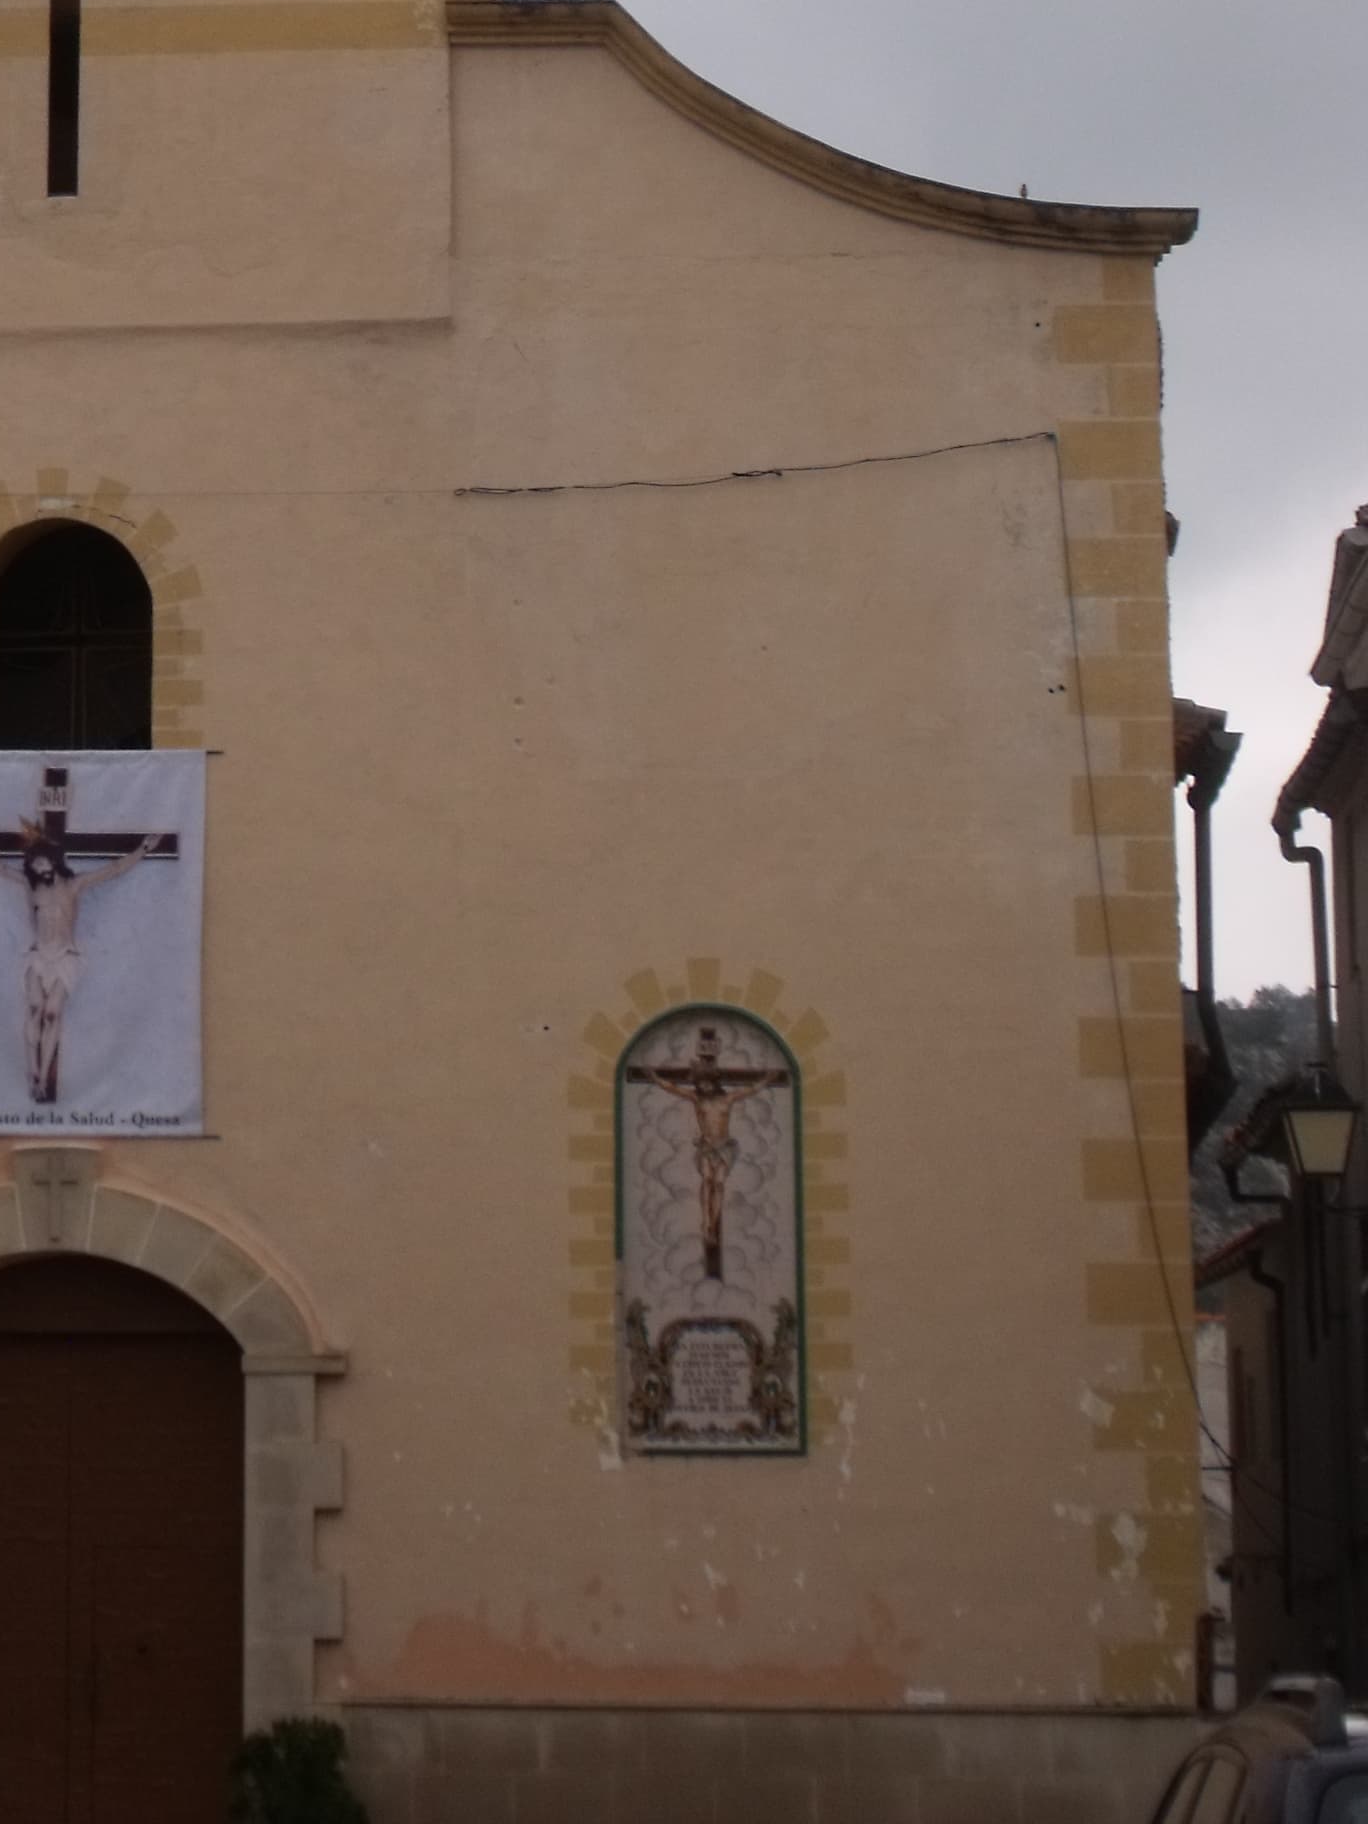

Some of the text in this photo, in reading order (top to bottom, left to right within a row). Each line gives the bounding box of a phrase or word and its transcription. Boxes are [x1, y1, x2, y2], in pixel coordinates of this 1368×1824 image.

[26, 1110, 44, 1126] de
[50, 1110, 64, 1126] la
[70, 1110, 114, 1126] Salud
[131, 1111, 181, 1128] Quesa
